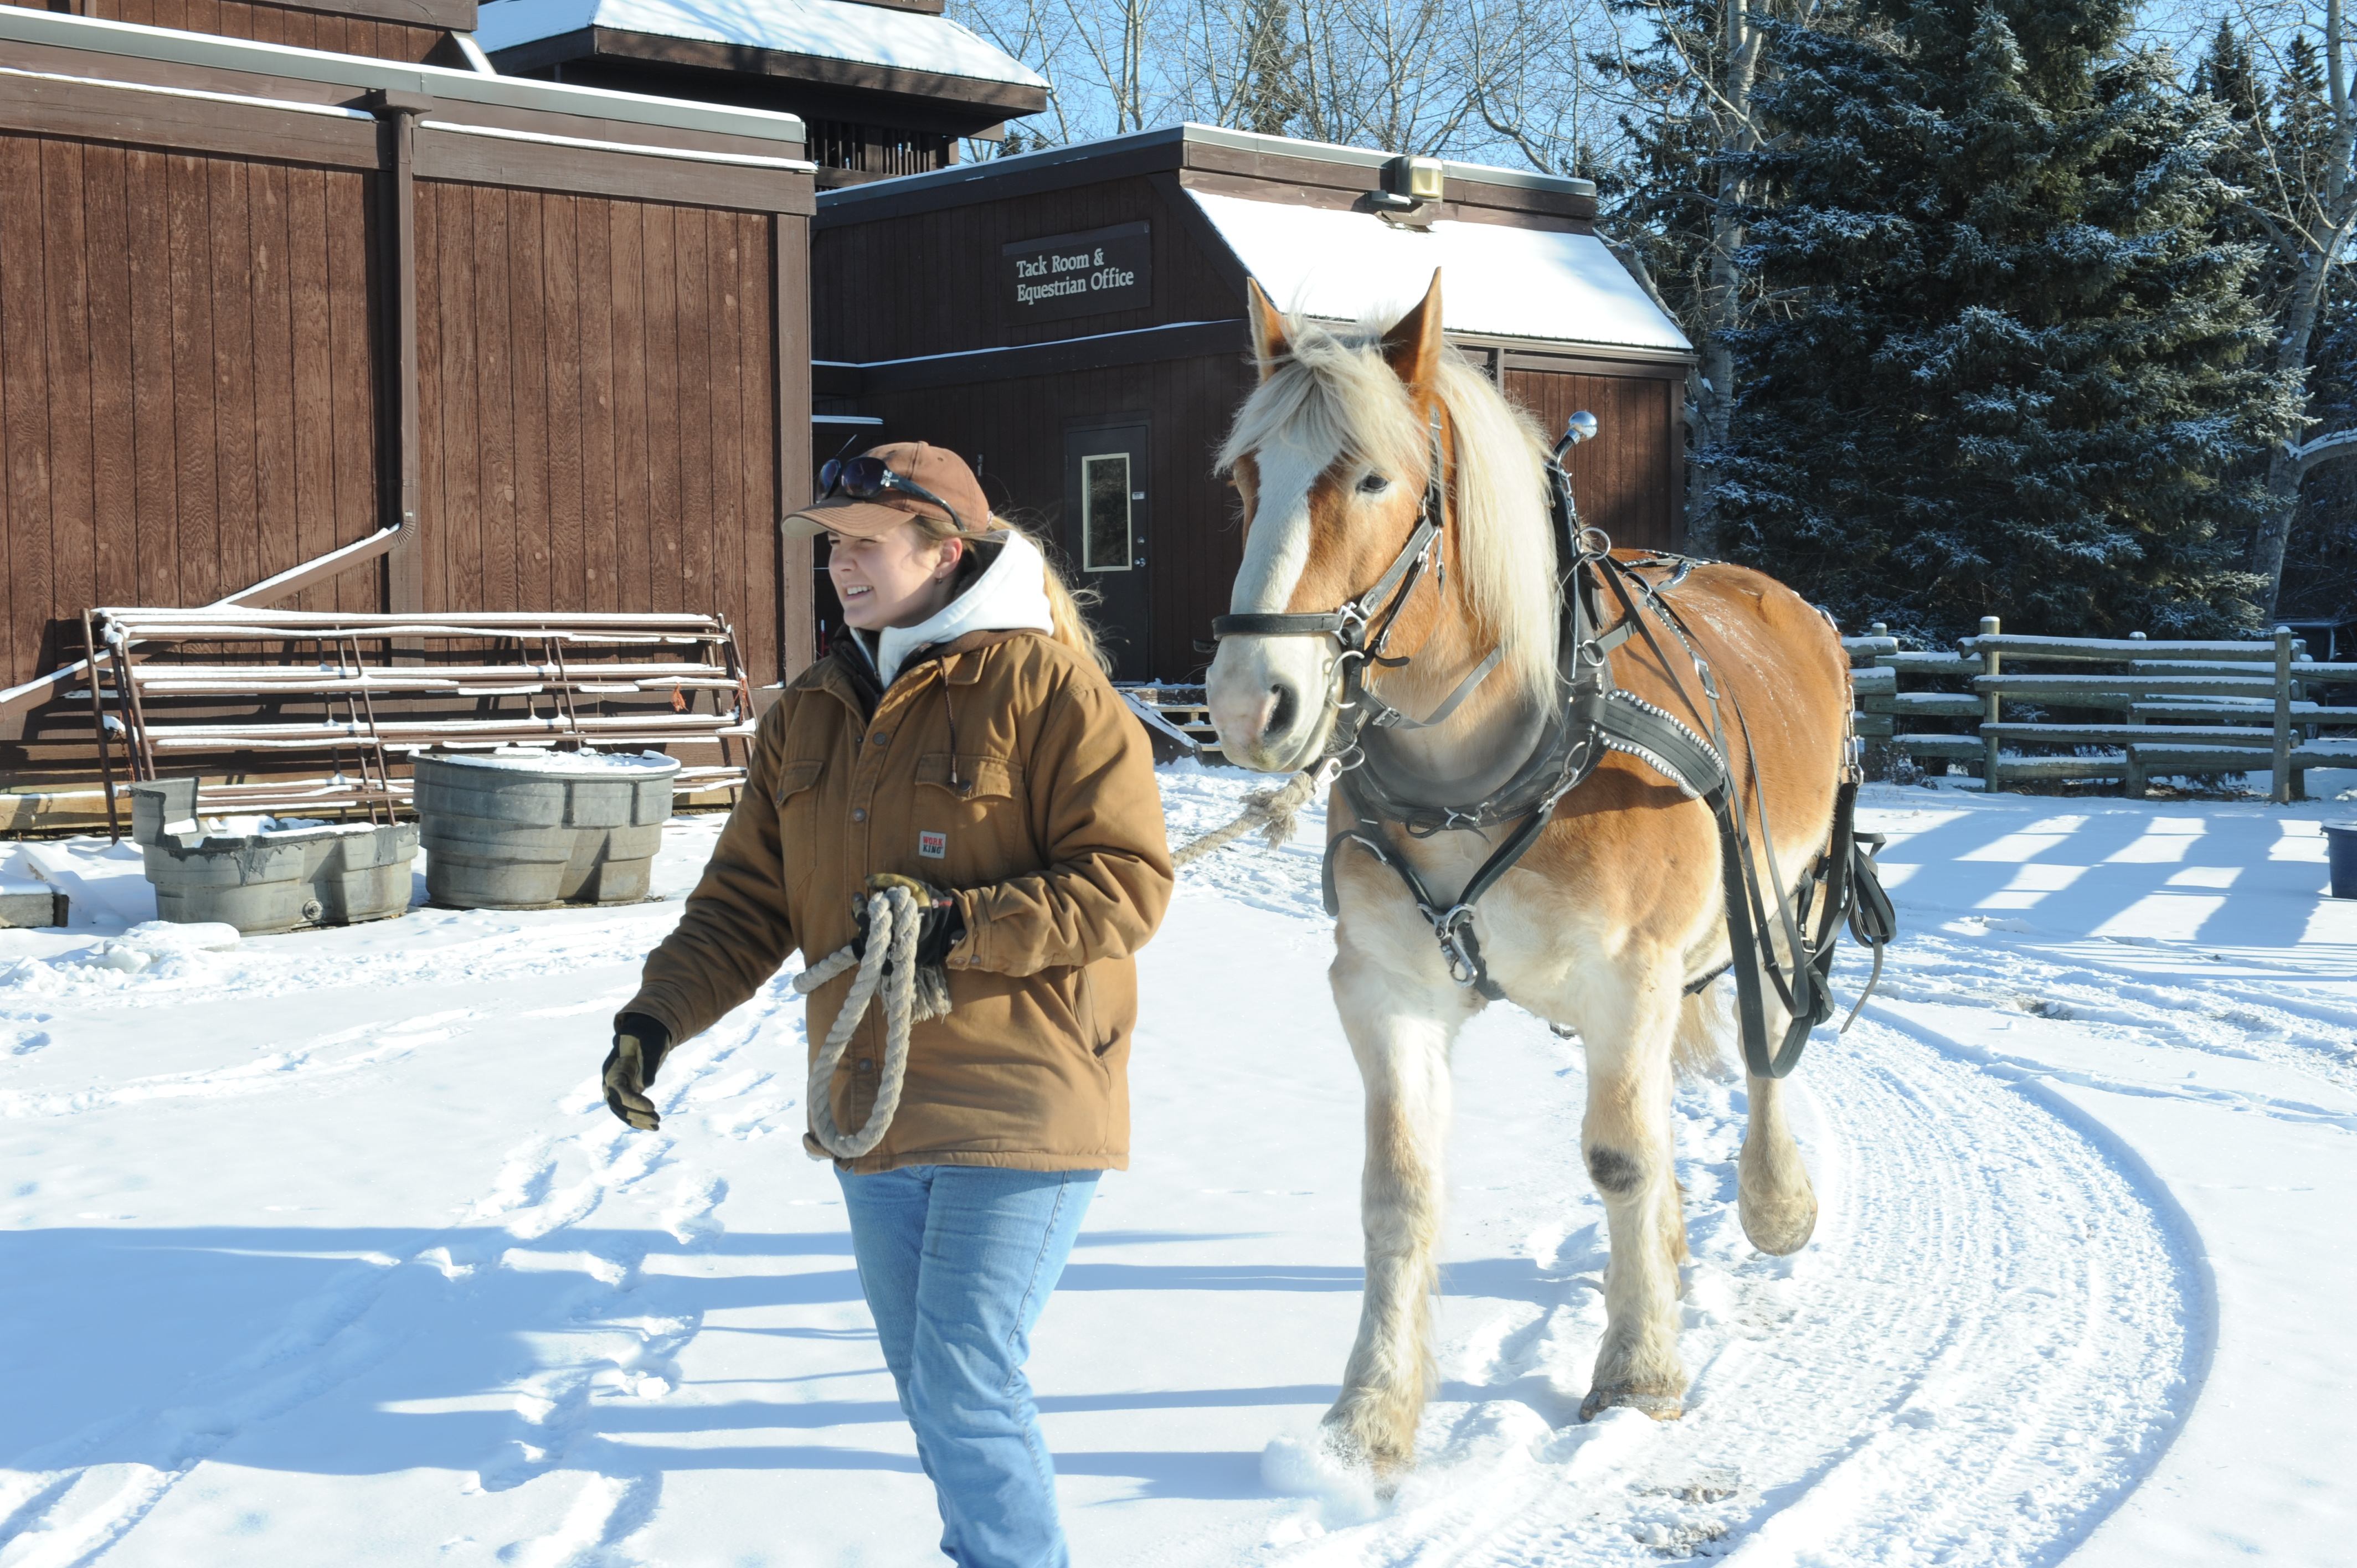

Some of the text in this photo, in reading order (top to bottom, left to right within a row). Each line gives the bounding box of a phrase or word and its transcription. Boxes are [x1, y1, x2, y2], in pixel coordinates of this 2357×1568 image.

[1016, 248, 1104, 278] Tack Room &
[1017, 267, 1134, 305] Equestrian Office
[923, 836, 943, 847] WORK
[923, 844, 941, 854] KING
